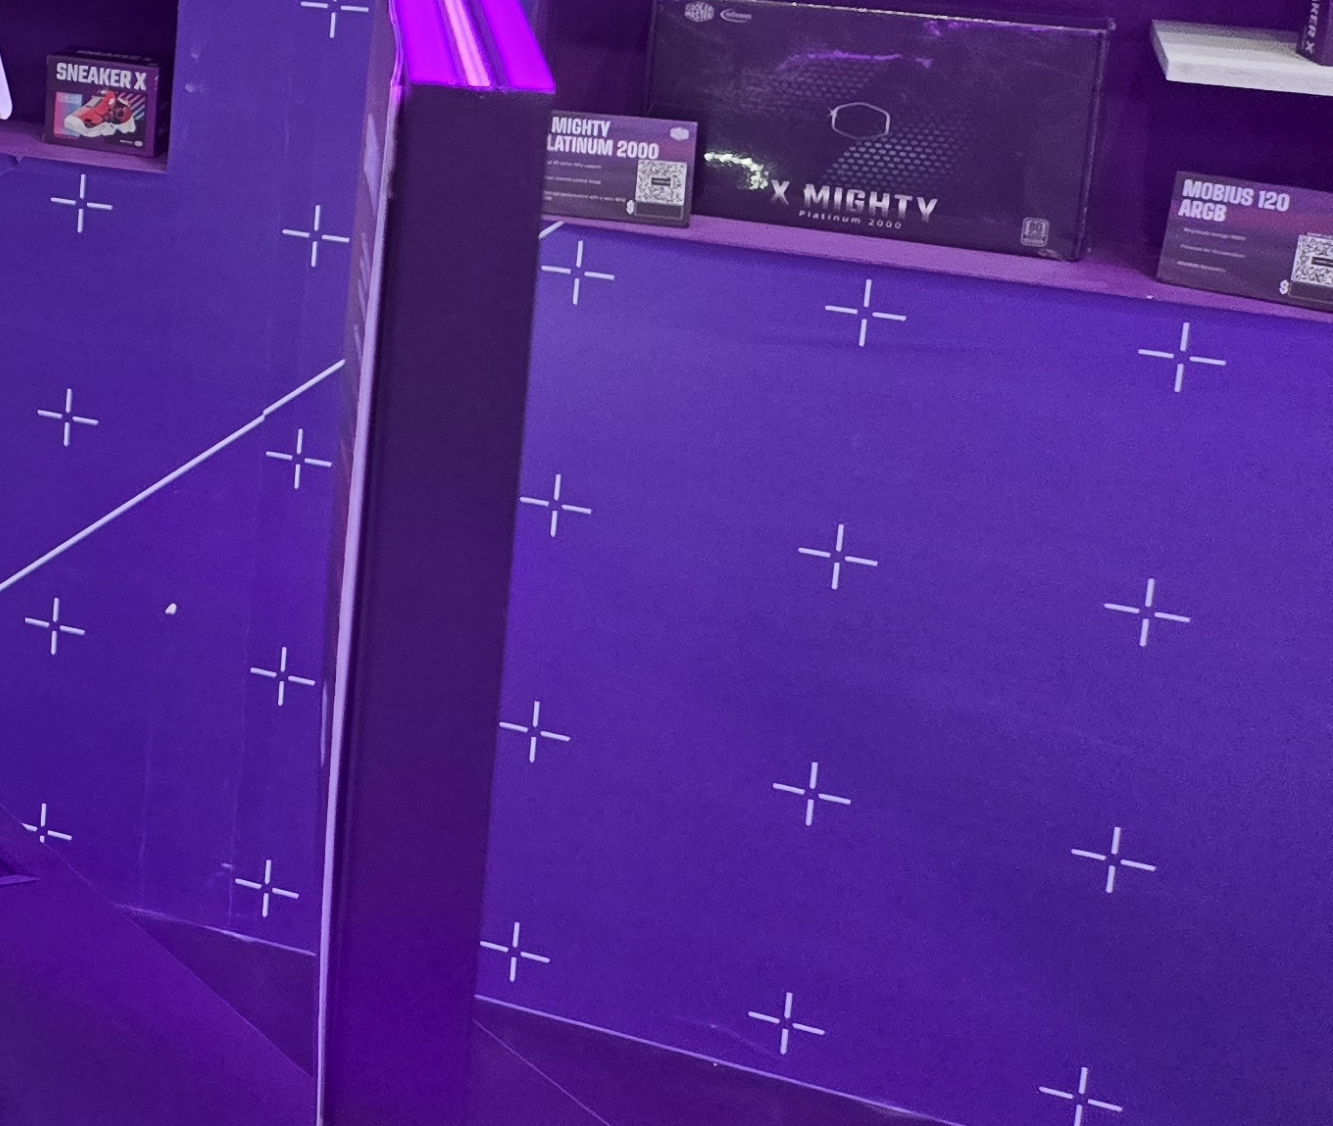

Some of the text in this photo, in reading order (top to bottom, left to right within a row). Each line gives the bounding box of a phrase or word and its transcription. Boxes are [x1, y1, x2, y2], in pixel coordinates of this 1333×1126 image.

[1305, 40, 1315, 54] X
[56, 62, 147, 91] SNEAKER X
[551, 116, 611, 137] MIGHTY
[546, 134, 659, 159] LATINUM 2000
[770, 179, 938, 222] X MIGHTY
[1182, 179, 1290, 212] MOBIUS 120
[626, 200, 634, 215] $
[1178, 199, 1227, 222] ARGB
[799, 209, 902, 230] Platinum 2000
[1278, 279, 1289, 295] $
